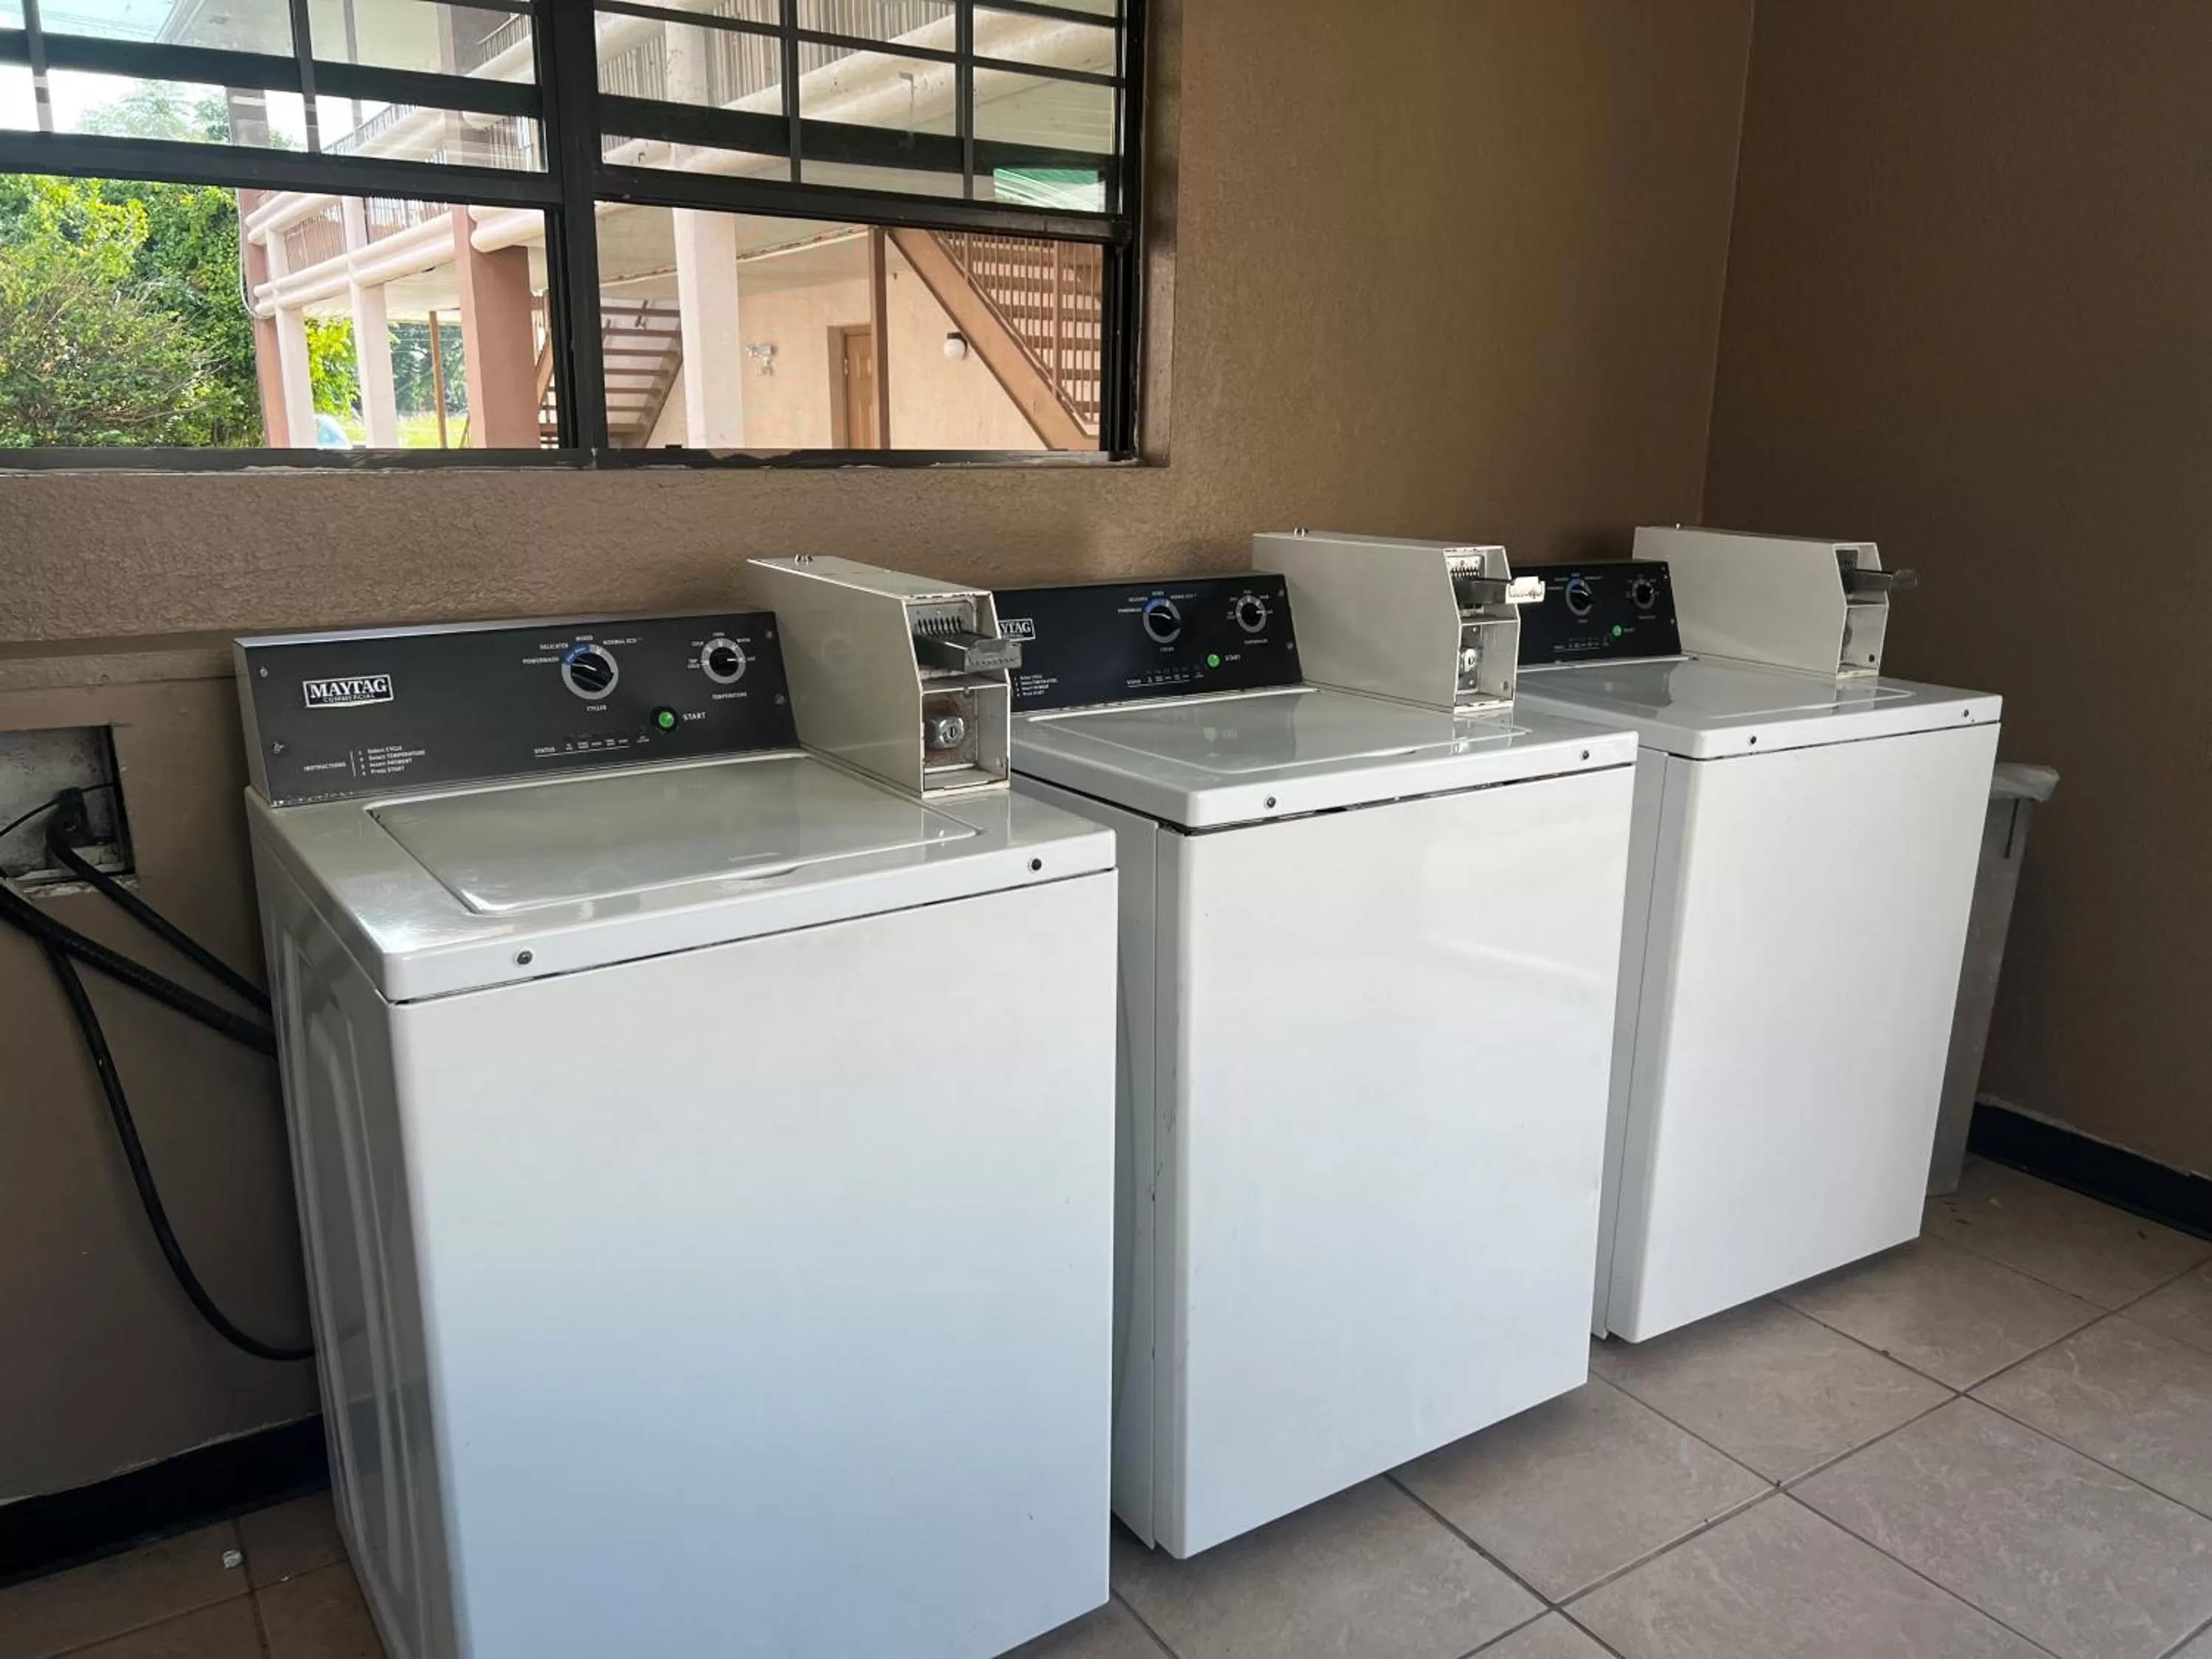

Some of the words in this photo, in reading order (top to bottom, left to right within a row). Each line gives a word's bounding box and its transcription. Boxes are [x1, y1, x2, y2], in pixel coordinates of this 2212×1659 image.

[999, 622, 1032, 634] YTAG
[309, 678, 388, 698] MAYTAG
[683, 711, 706, 721] START
